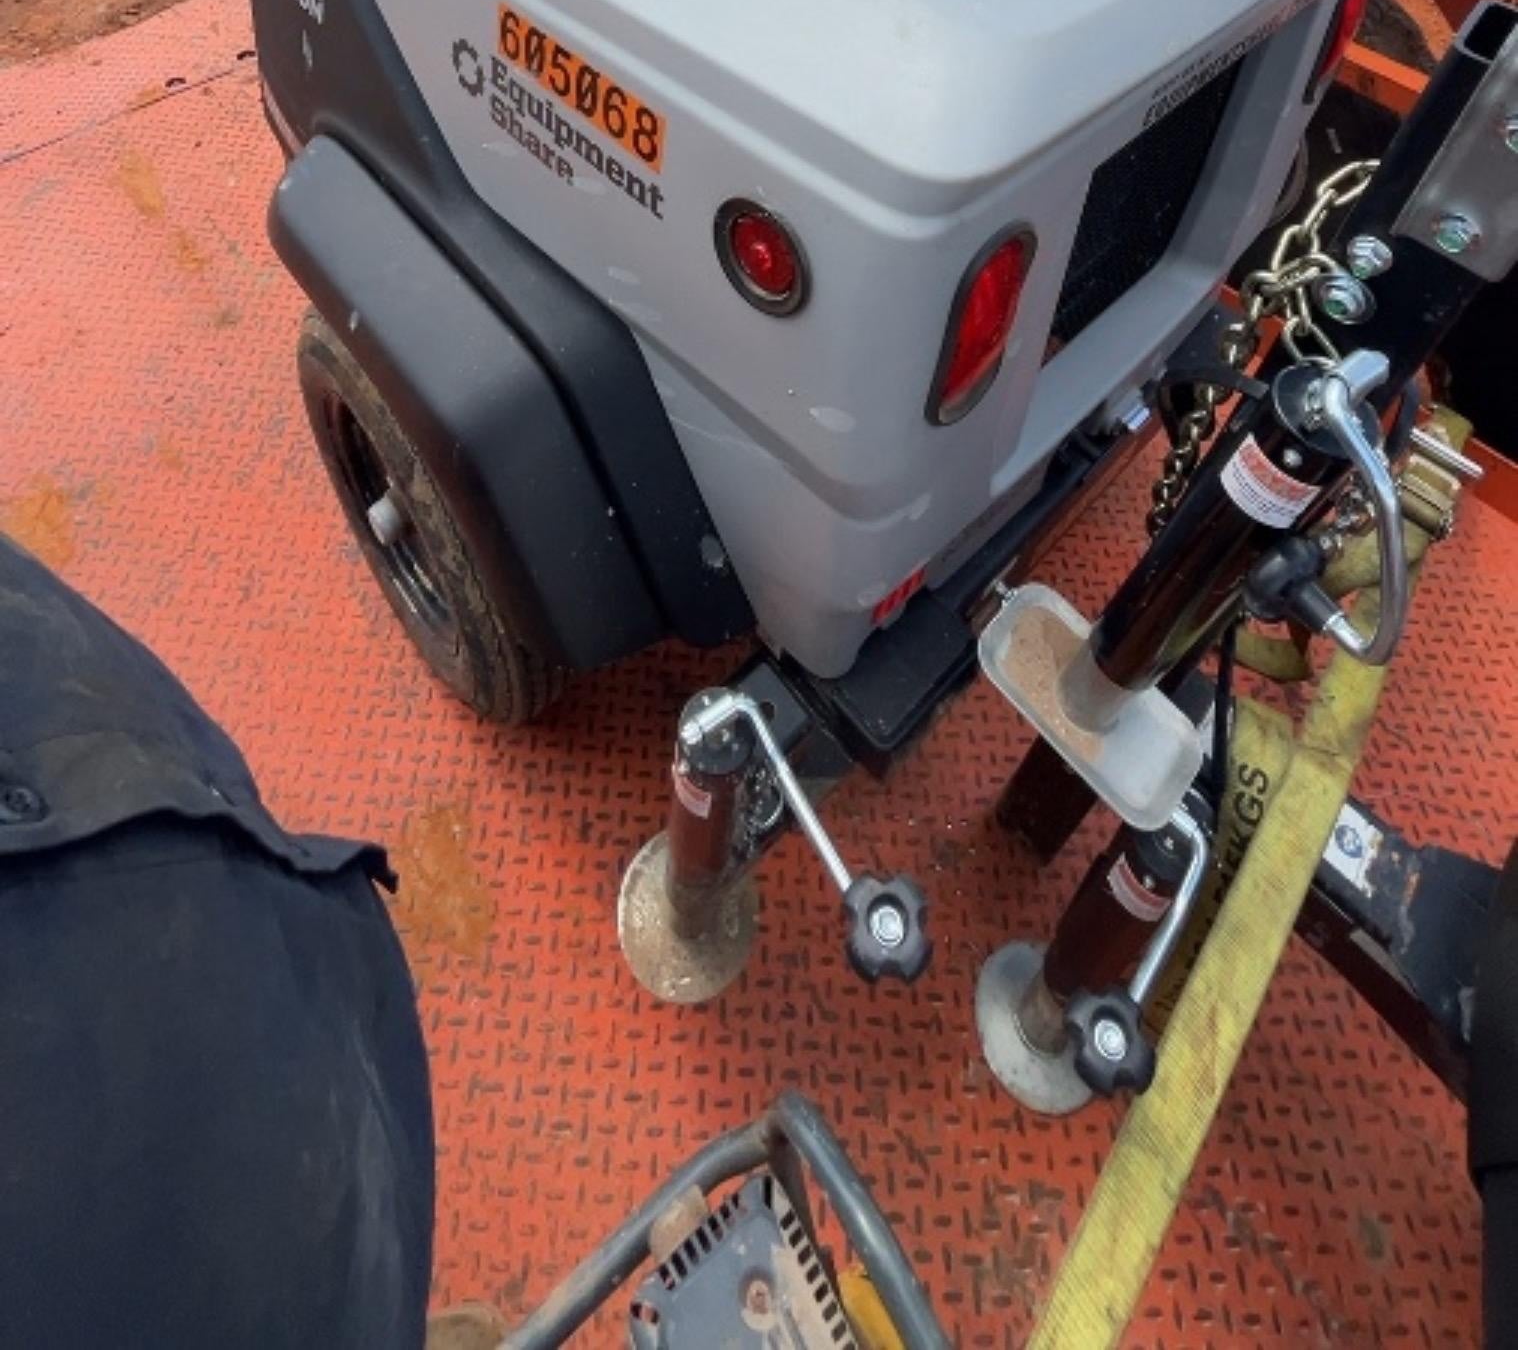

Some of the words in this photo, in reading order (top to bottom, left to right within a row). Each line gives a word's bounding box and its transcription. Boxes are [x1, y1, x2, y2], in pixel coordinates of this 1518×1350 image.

[490, 93, 574, 187] Share
[491, 54, 665, 221] Equipment
[500, 10, 659, 163] 605068
